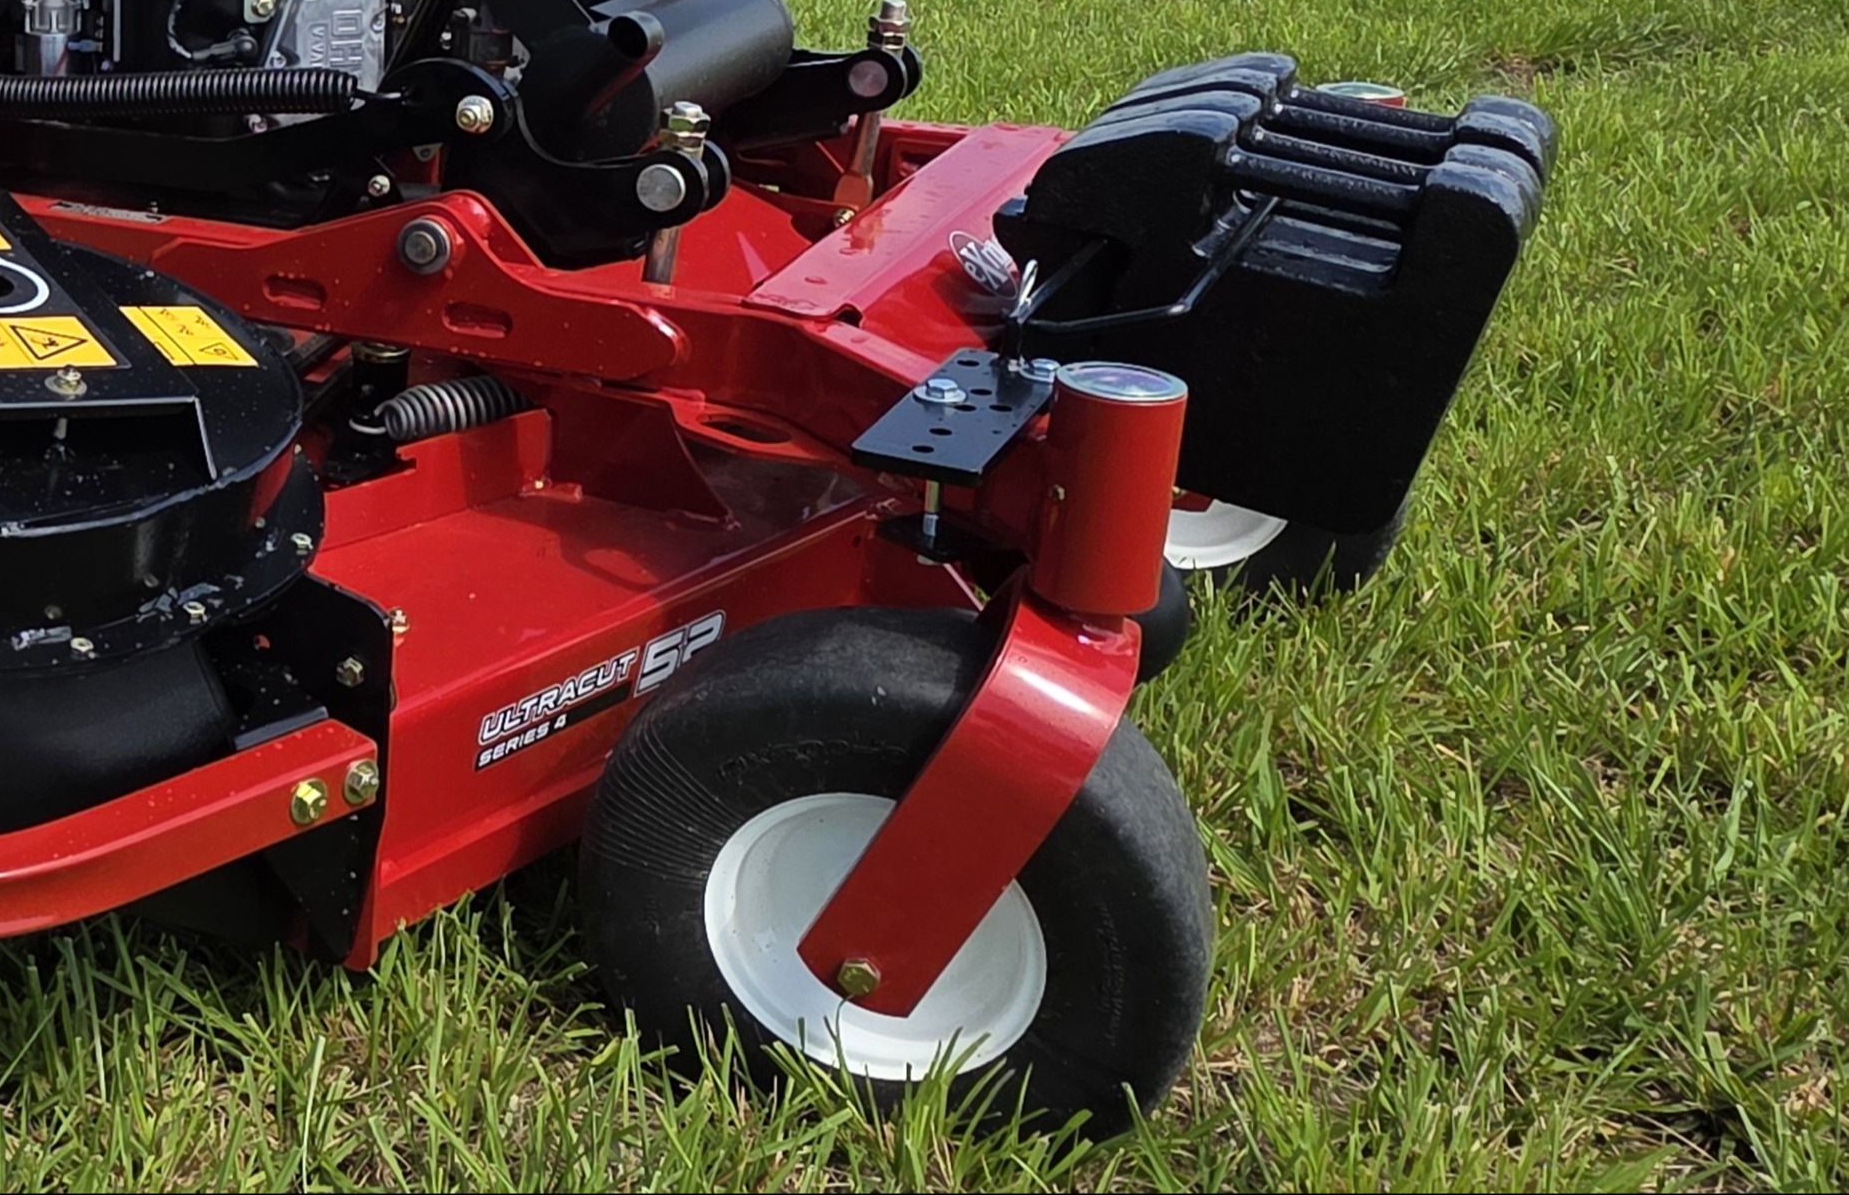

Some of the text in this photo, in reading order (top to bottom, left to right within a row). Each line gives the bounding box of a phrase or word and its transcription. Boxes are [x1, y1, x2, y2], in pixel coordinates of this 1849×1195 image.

[479, 649, 639, 745] ULTRACUT
[477, 712, 568, 768] SERIES 4
